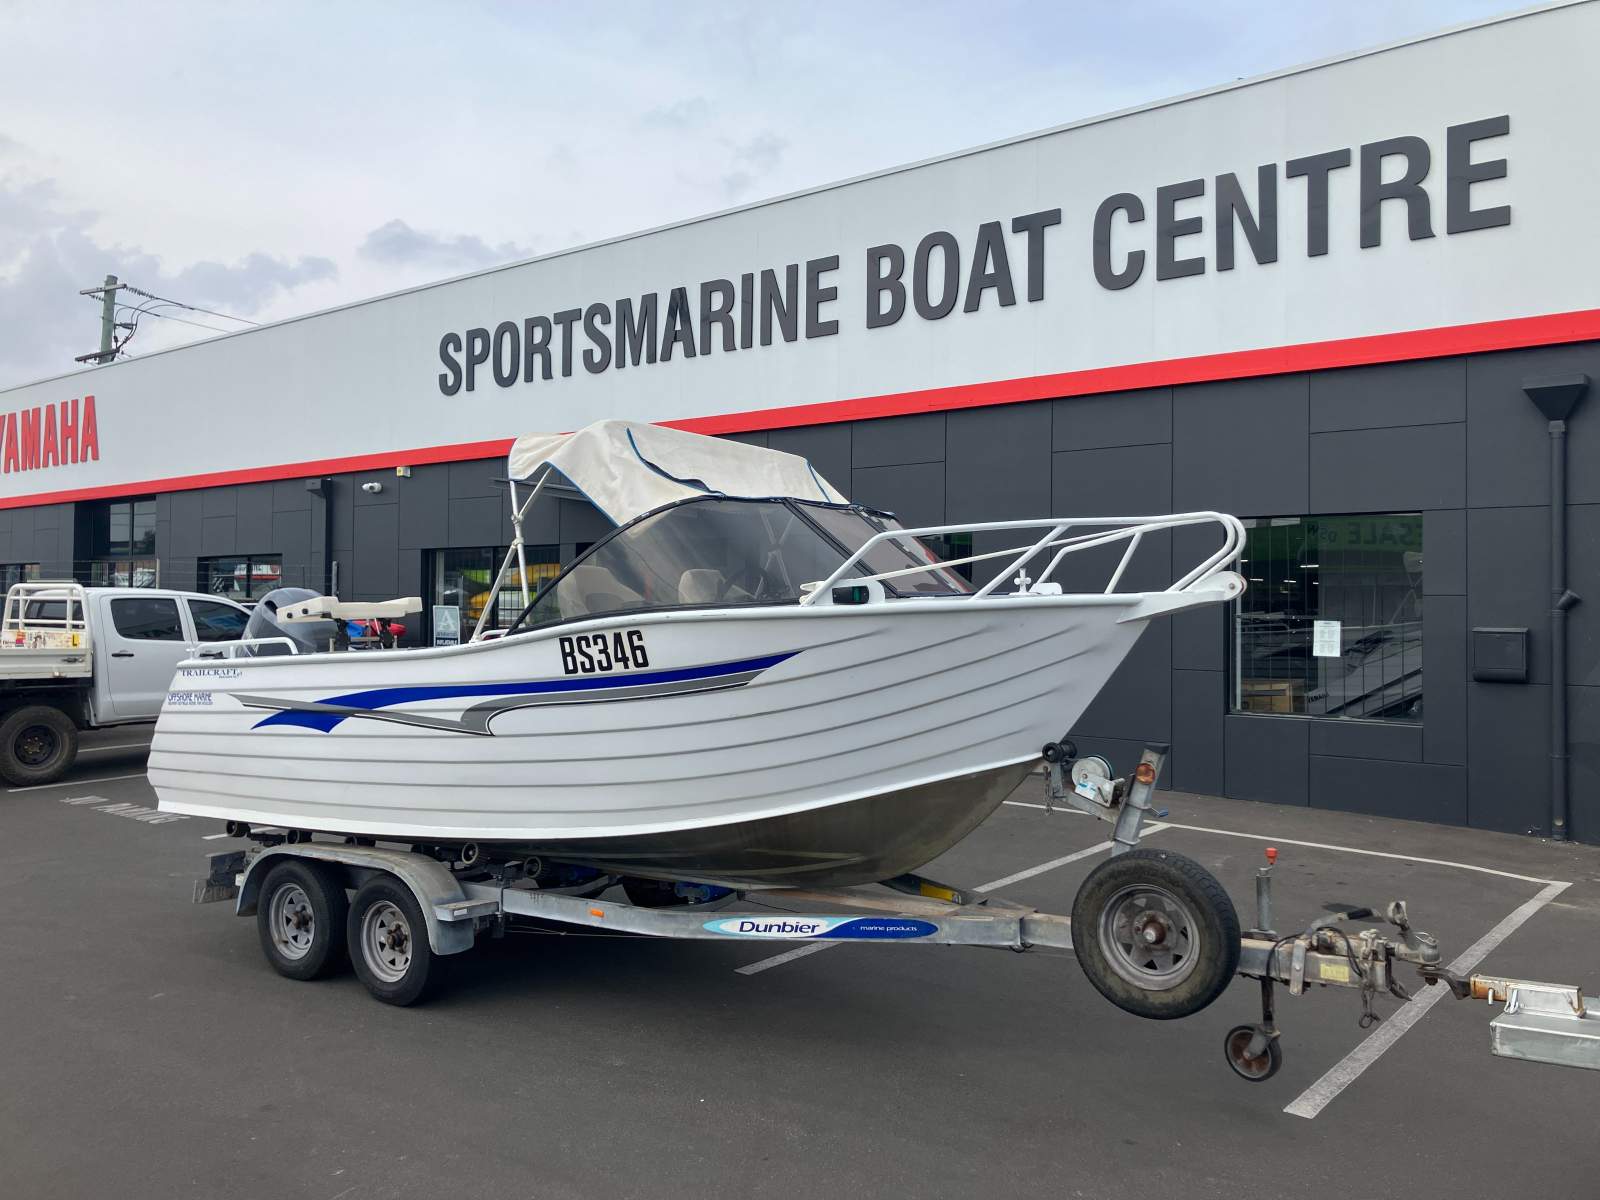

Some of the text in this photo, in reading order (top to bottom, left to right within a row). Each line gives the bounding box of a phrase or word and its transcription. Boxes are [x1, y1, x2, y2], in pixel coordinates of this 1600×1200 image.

[439, 114, 1512, 397] SPORTSMARINE BOAT CENTRE
[559, 630, 649, 675] BS346
[180, 668, 237, 677] TRAILCRAFT
[168, 692, 213, 702] OFFSHORE MARINE
[739, 920, 820, 935] Dunbier
[886, 925, 918, 933] products
